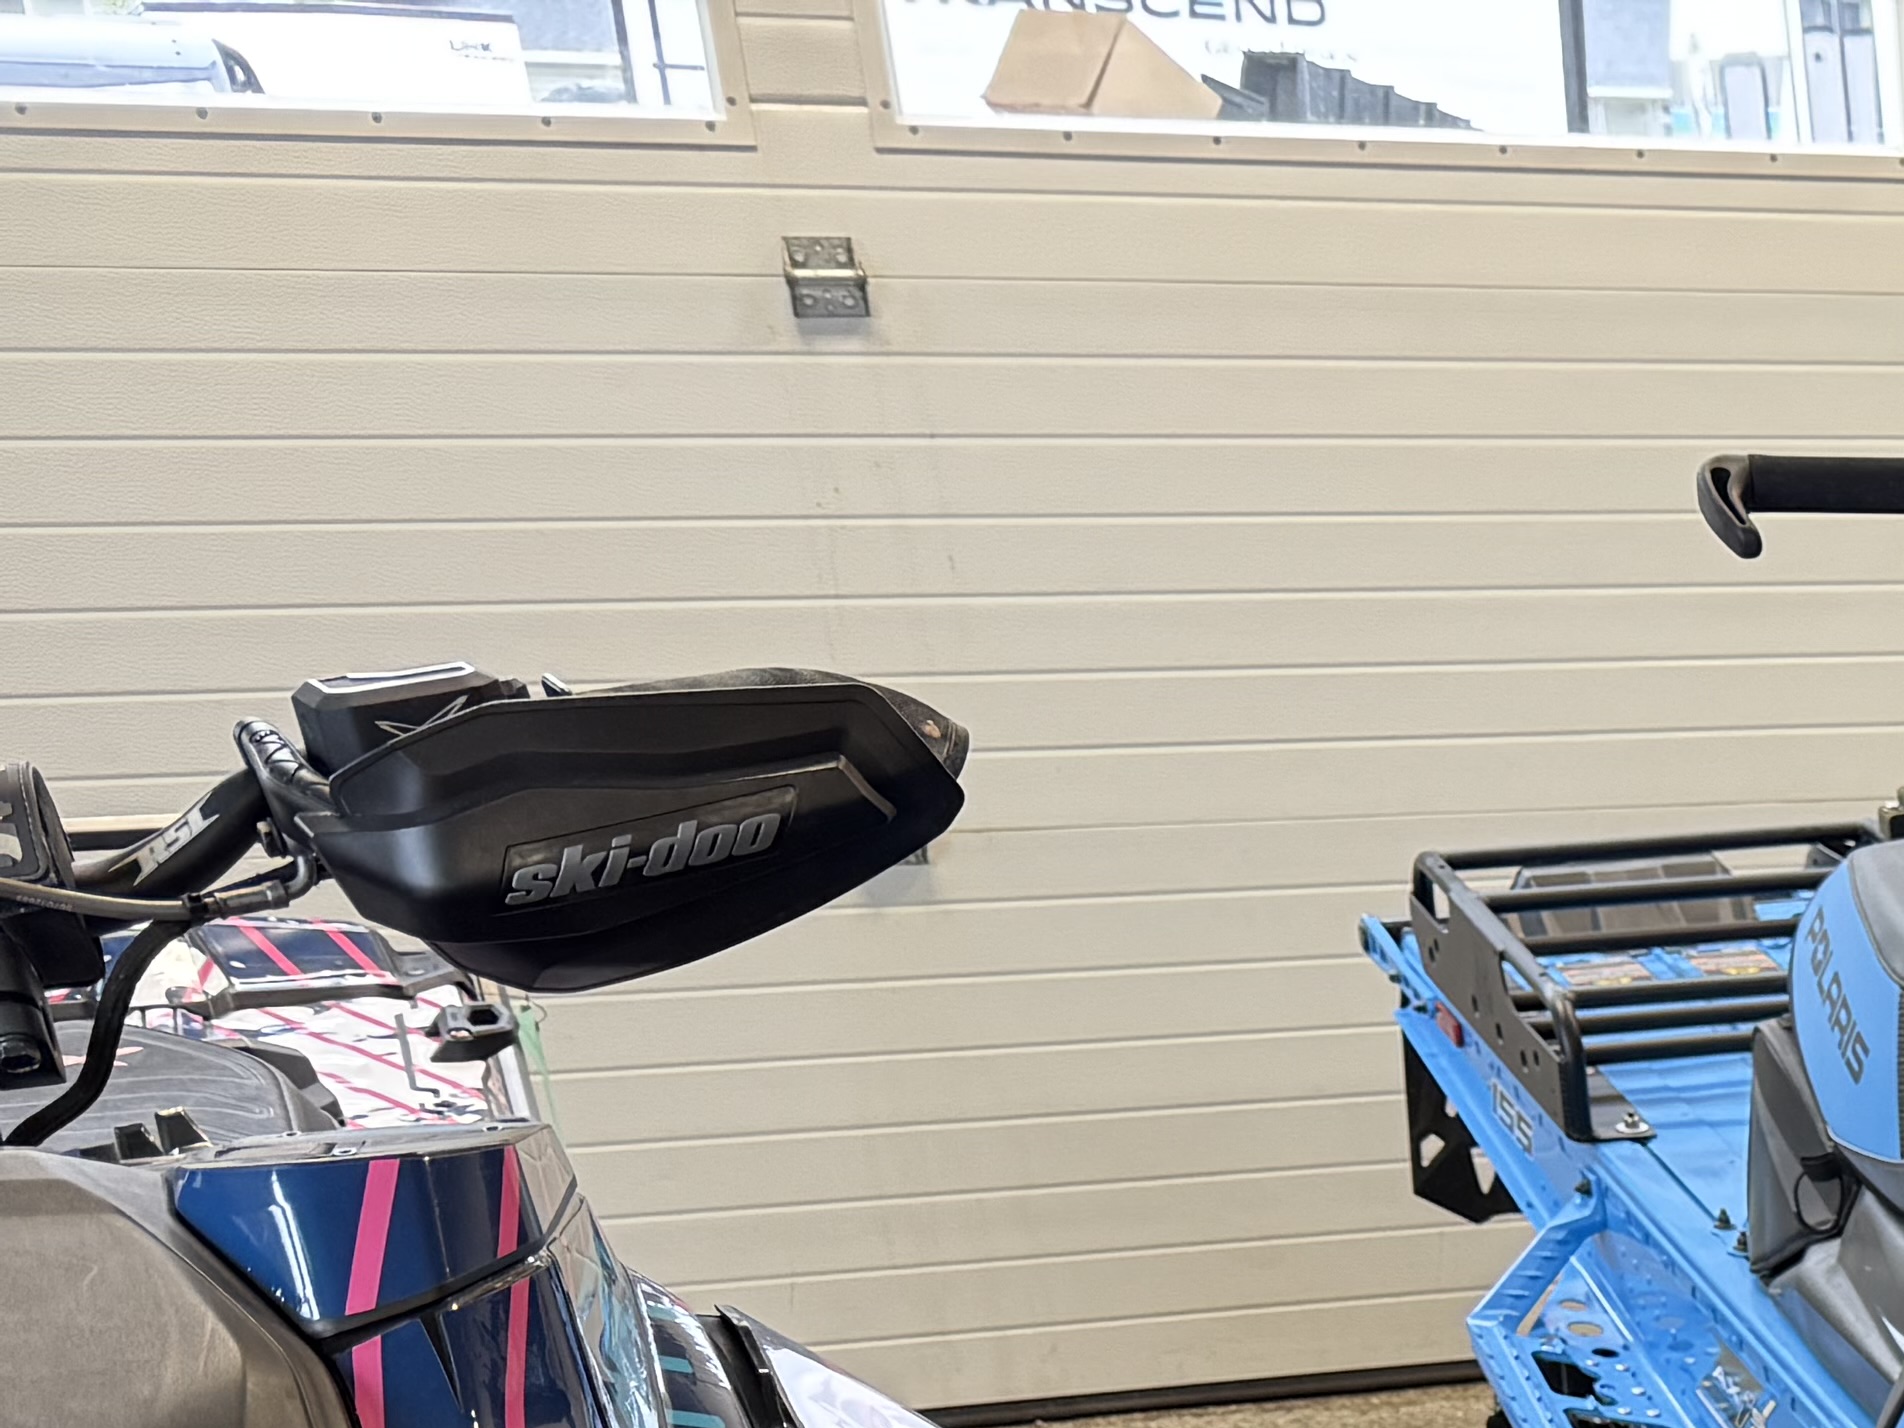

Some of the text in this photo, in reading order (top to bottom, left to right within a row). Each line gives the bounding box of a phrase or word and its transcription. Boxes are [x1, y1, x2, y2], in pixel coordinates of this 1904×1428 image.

[904, 0, 1326, 28] SCEND
[505, 813, 781, 906] ski-doo
[1805, 906, 1871, 1086] POLARIS
